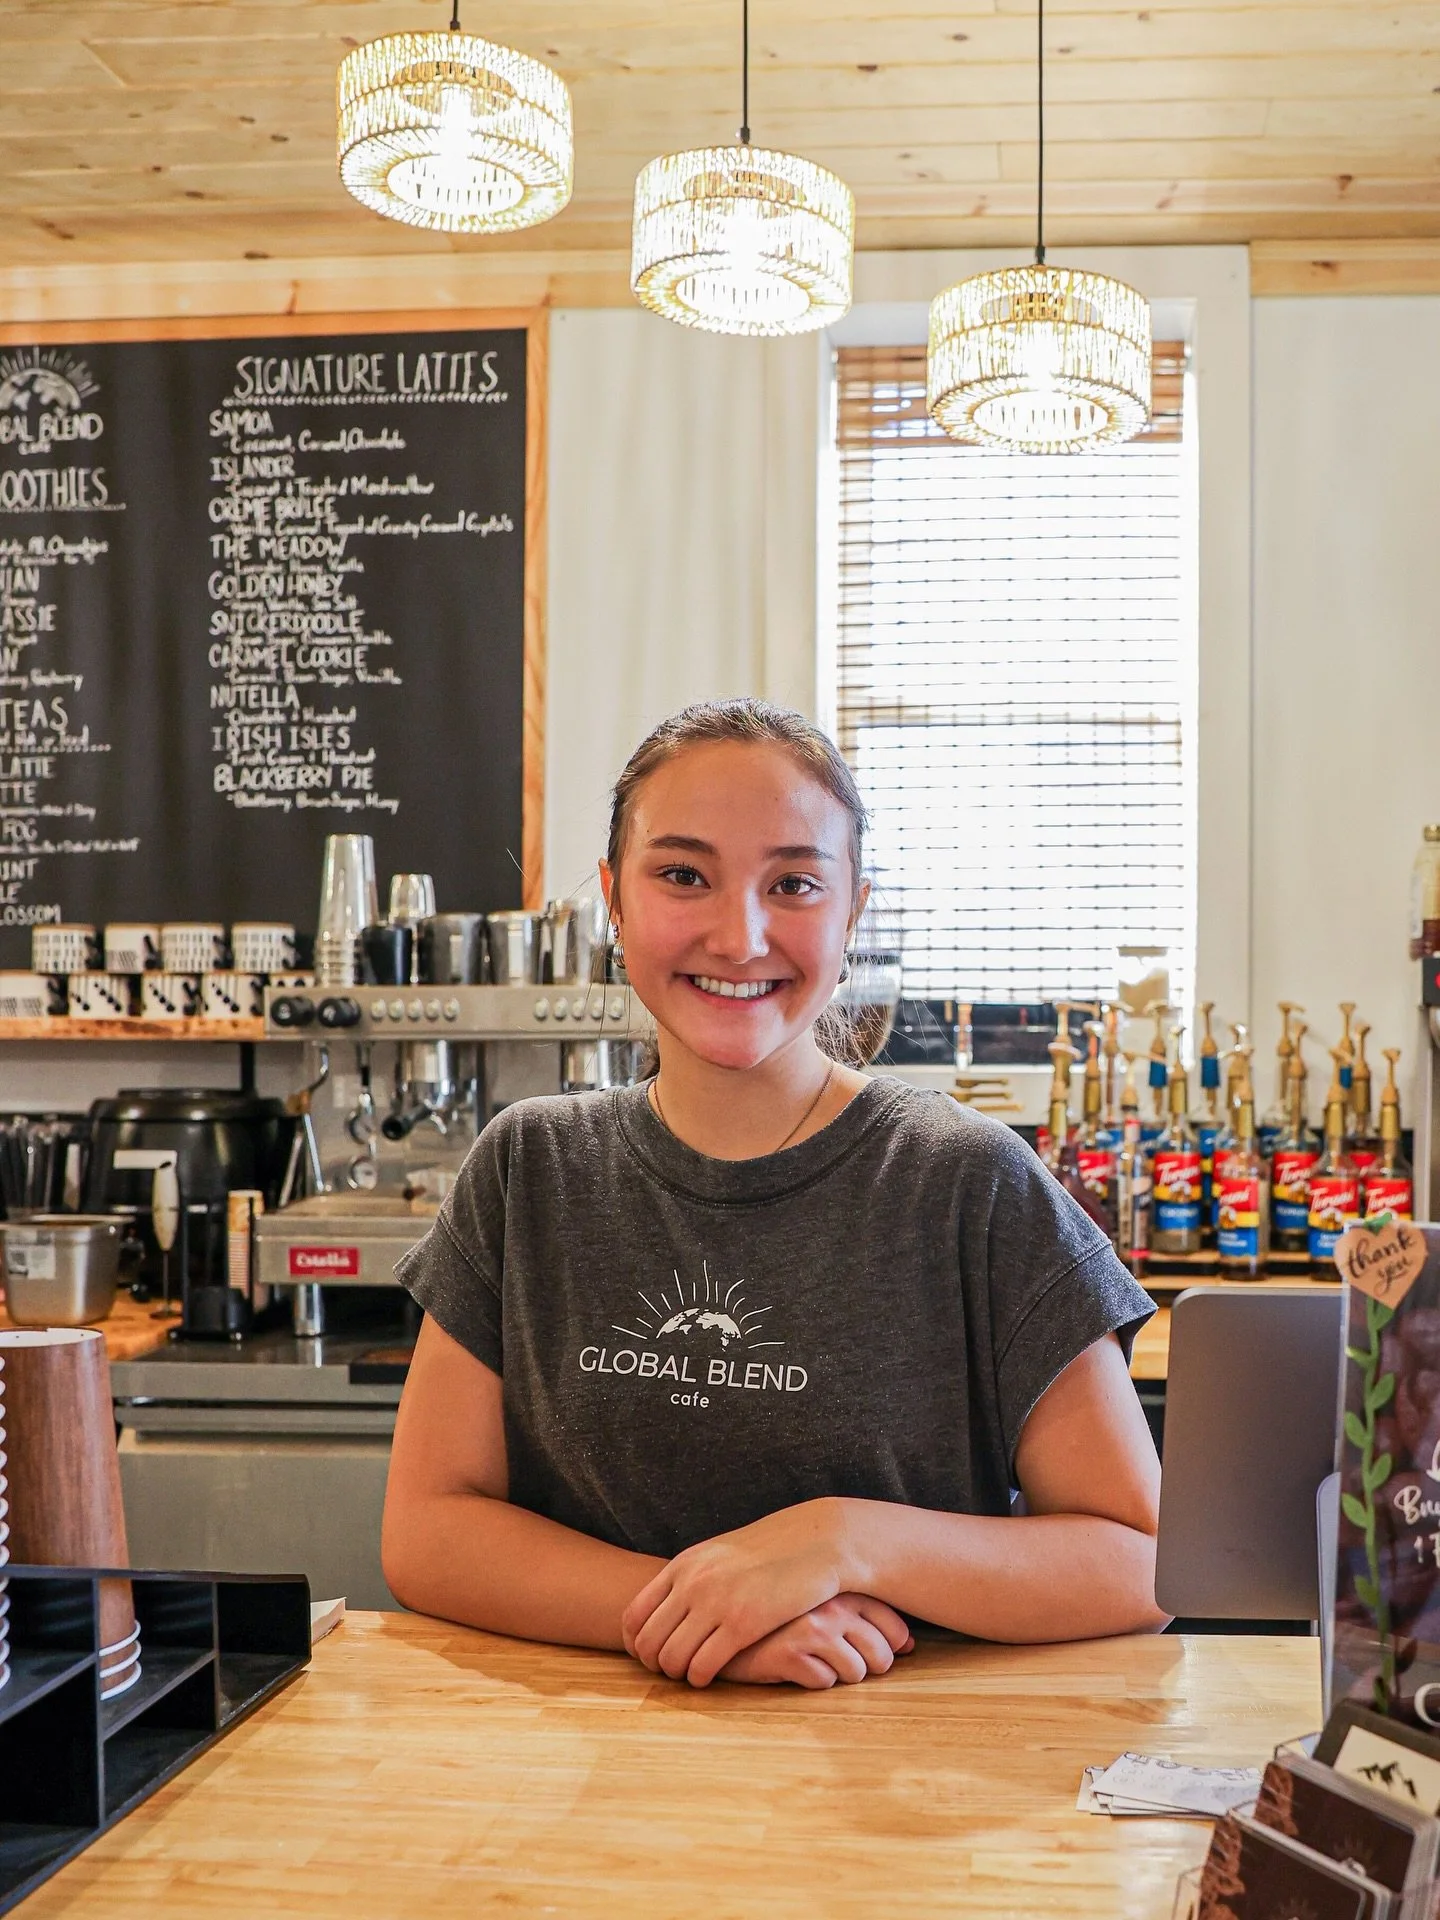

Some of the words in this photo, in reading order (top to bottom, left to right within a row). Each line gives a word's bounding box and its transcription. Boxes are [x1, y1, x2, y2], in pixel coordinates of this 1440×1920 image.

[233, 353, 386, 399] SIGNATURE
[397, 351, 499, 393] LATTES
[39, 412, 103, 441] BLEND
[208, 409, 274, 437] SAMOA
[210, 455, 295, 482] ISLANDER
[210, 536, 251, 560] THE
[258, 534, 349, 560] MEADOW
[208, 570, 284, 600] GOLDEN
[287, 573, 344, 598] HONEY
[208, 609, 365, 636] SNICKERDOODLE
[208, 644, 293, 670] CARAMEL
[296, 643, 369, 670] COOKIE
[210, 684, 301, 709] NUTELLA
[0, 696, 69, 732] TEAS
[211, 726, 282, 751] IRISH
[289, 725, 351, 750] ISLES
[213, 763, 333, 793] BLACKBERRY
[341, 766, 374, 790] PIE
[1348, 1222, 1416, 1279] thank
[1374, 1256, 1414, 1297] you
[579, 1346, 697, 1384] GLOBAL
[707, 1359, 808, 1392] BLEND
[670, 1391, 710, 1408] cafe
